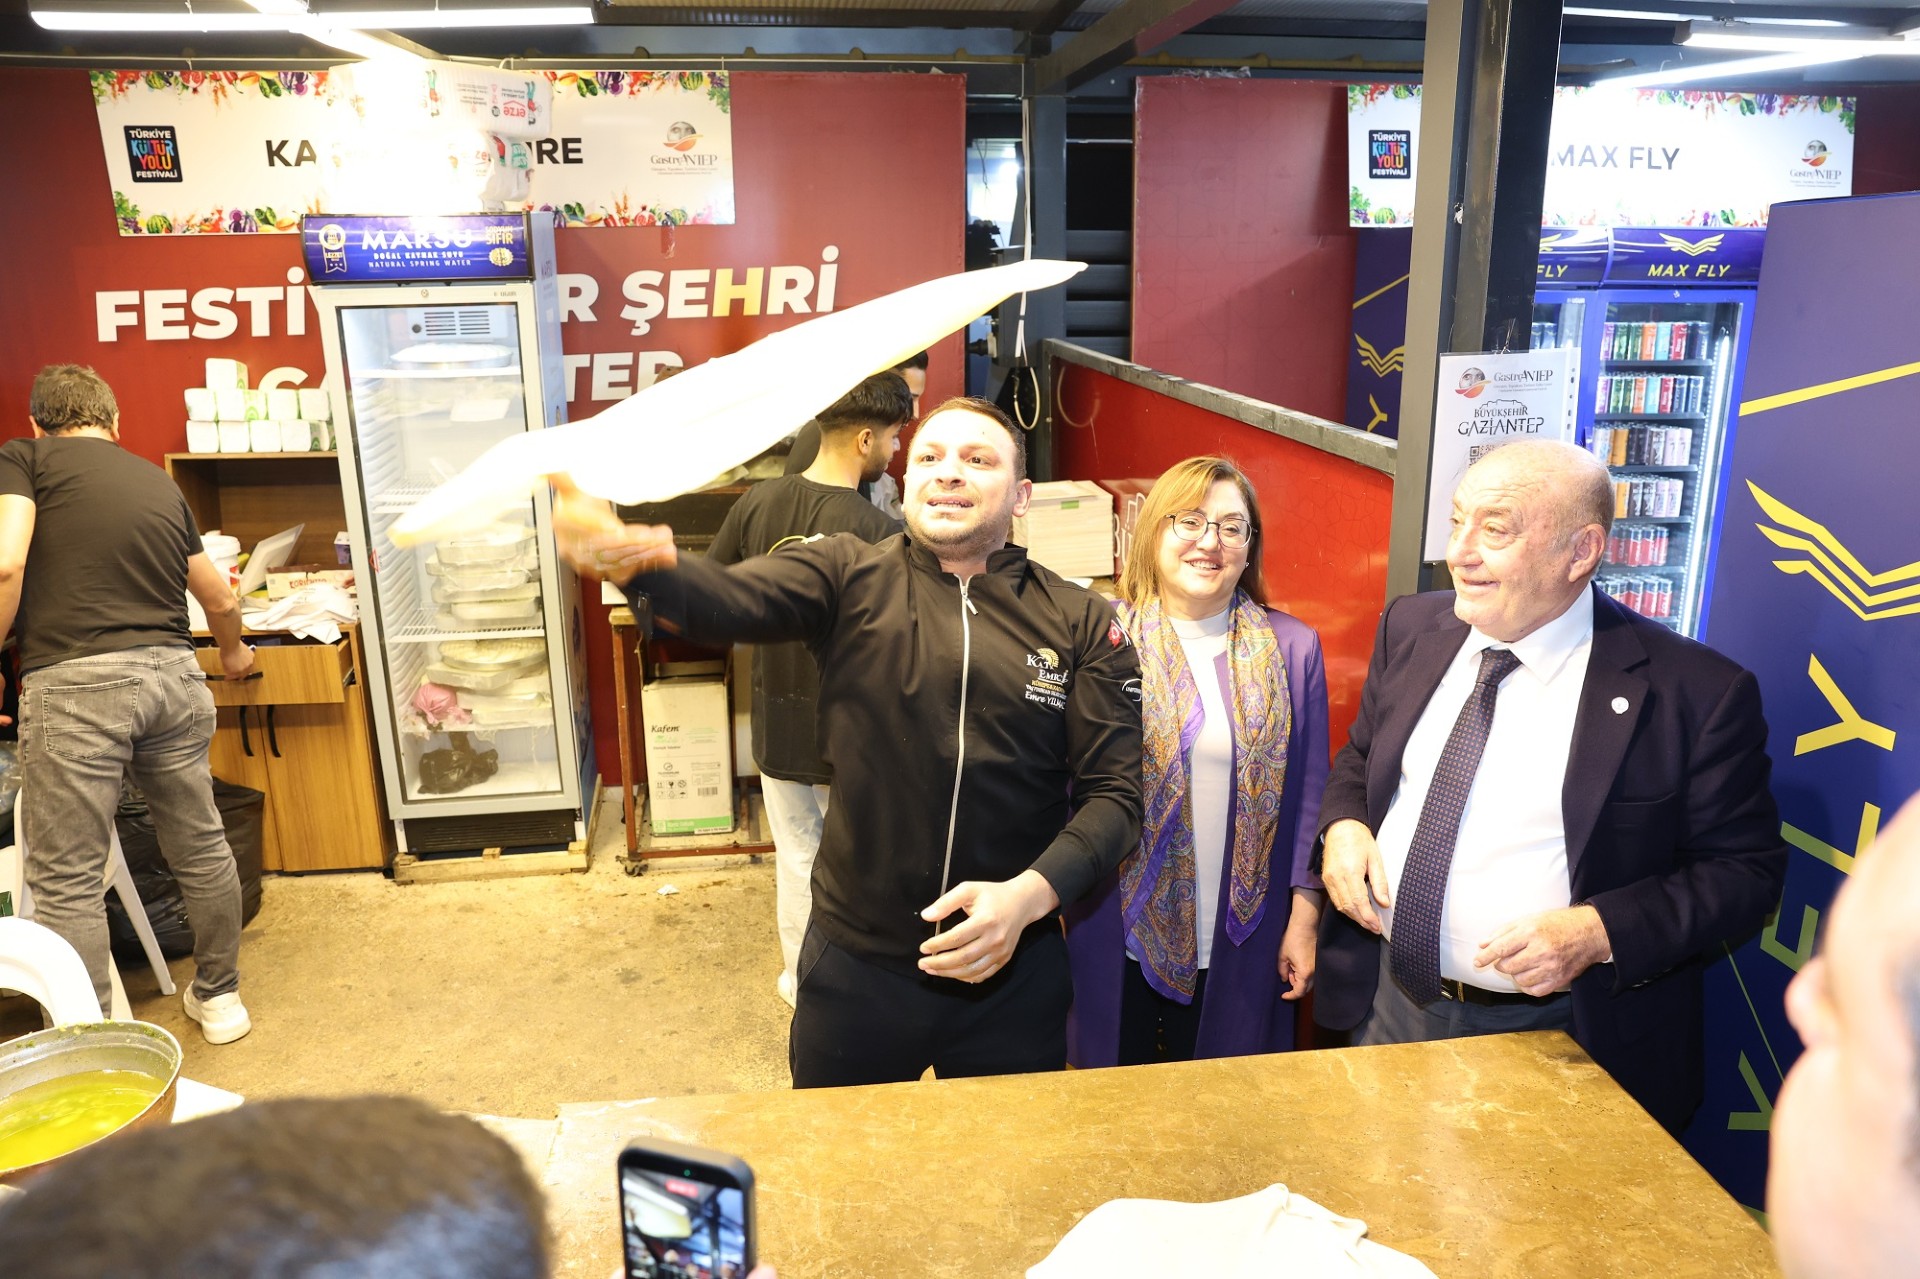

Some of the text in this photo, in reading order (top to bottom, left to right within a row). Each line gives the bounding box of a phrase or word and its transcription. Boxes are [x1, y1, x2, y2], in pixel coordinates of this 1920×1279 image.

[129, 128, 171, 138] TÜRKİYE
[1372, 132, 1407, 141] TÜRKİYE
[131, 140, 174, 156] KÜLTÜR
[525, 137, 583, 164] RE
[1372, 142, 1407, 156] KÜLTÜR
[139, 153, 172, 170] YOLU
[1377, 154, 1404, 168] YOLU
[1551, 144, 1680, 170] MAX FLY
[136, 169, 178, 178] FESTİVALİ
[1372, 168, 1407, 176] FESTİVALİ
[362, 229, 472, 250] MARSU
[368, 259, 472, 268] NATURAL SPRING WATER
[1647, 264, 1731, 277] MAX FLY
[1537, 264, 1568, 278] FLY
[620, 245, 839, 336] ŞEHRİ
[96, 266, 318, 342] FESTİ
[1458, 416, 1545, 437] GAZİANTEP
[1025, 690, 1046, 703] Emre
[651, 724, 680, 733] Kafem
